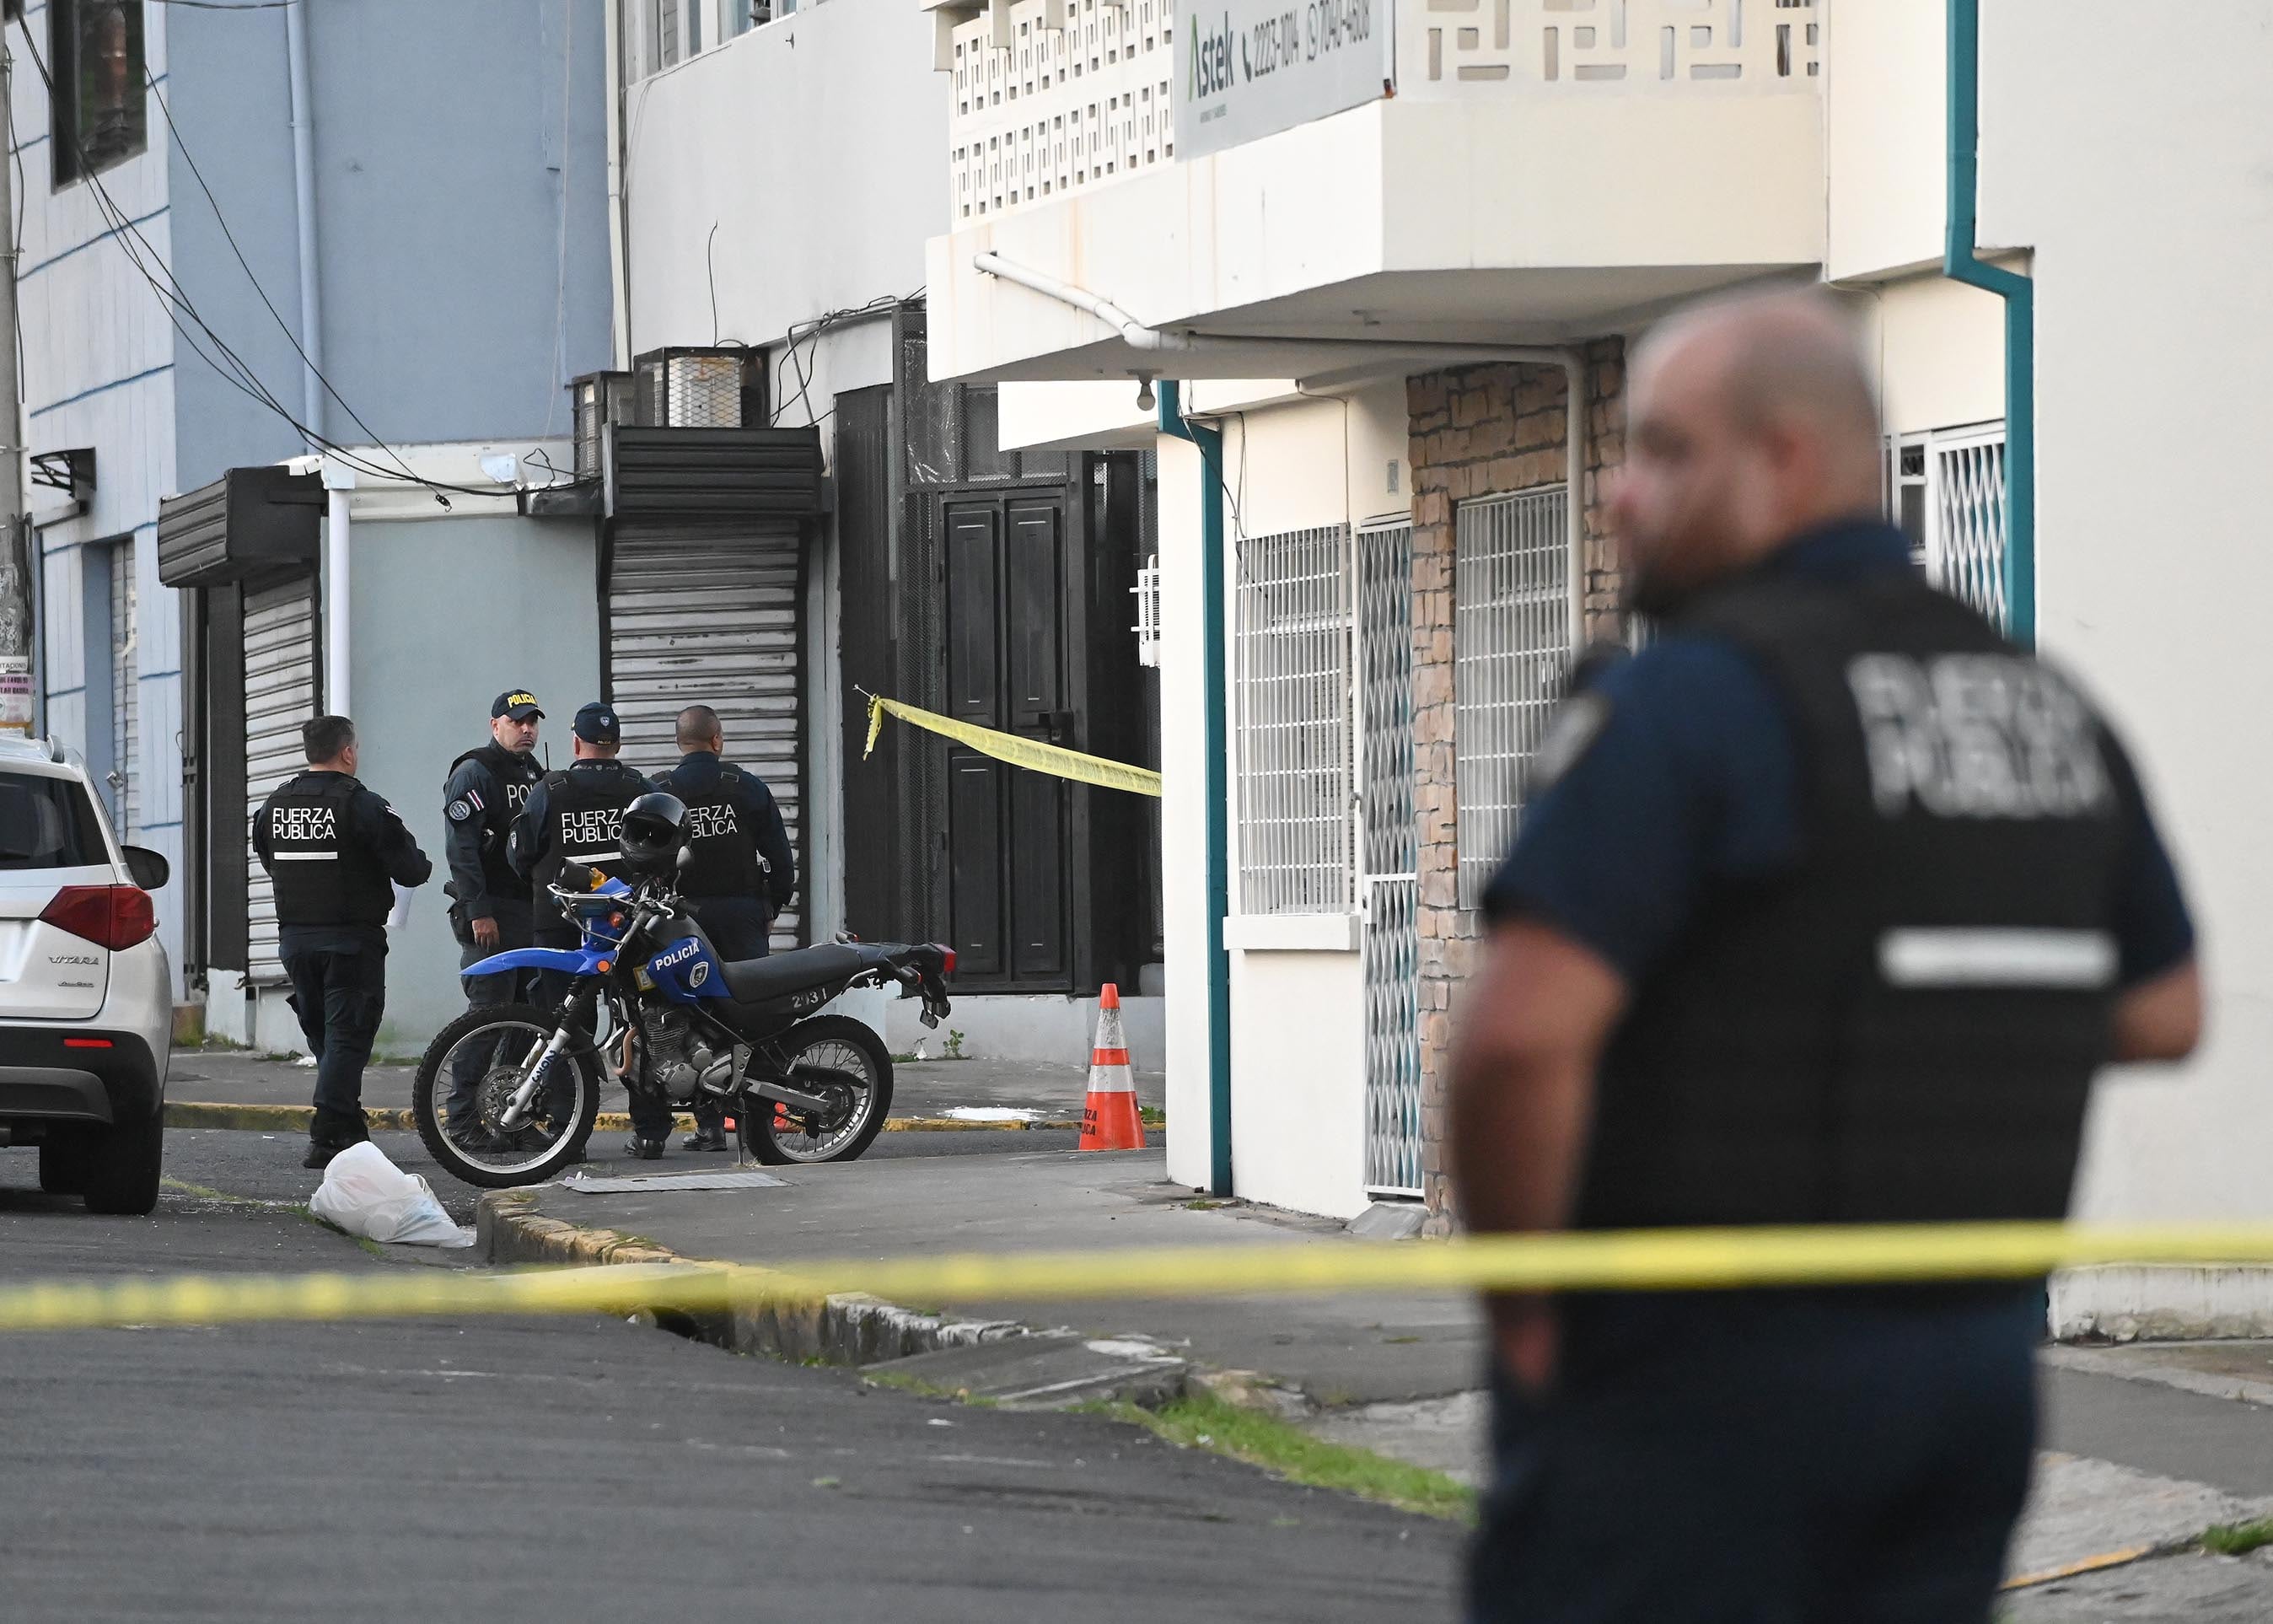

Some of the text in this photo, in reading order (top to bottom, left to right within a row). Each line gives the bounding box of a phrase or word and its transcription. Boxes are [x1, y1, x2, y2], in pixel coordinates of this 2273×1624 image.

[1189, 11, 1234, 102] Astek
[506, 783, 534, 809] PO
[272, 807, 336, 824] FUERZA
[689, 804, 736, 822] ERZA
[272, 823, 336, 840] PUBLICA
[562, 826, 622, 844] PUBLIC
[690, 820, 738, 840] BLICA
[48, 956, 99, 965] VITARA
[654, 941, 701, 971] POLICIA
